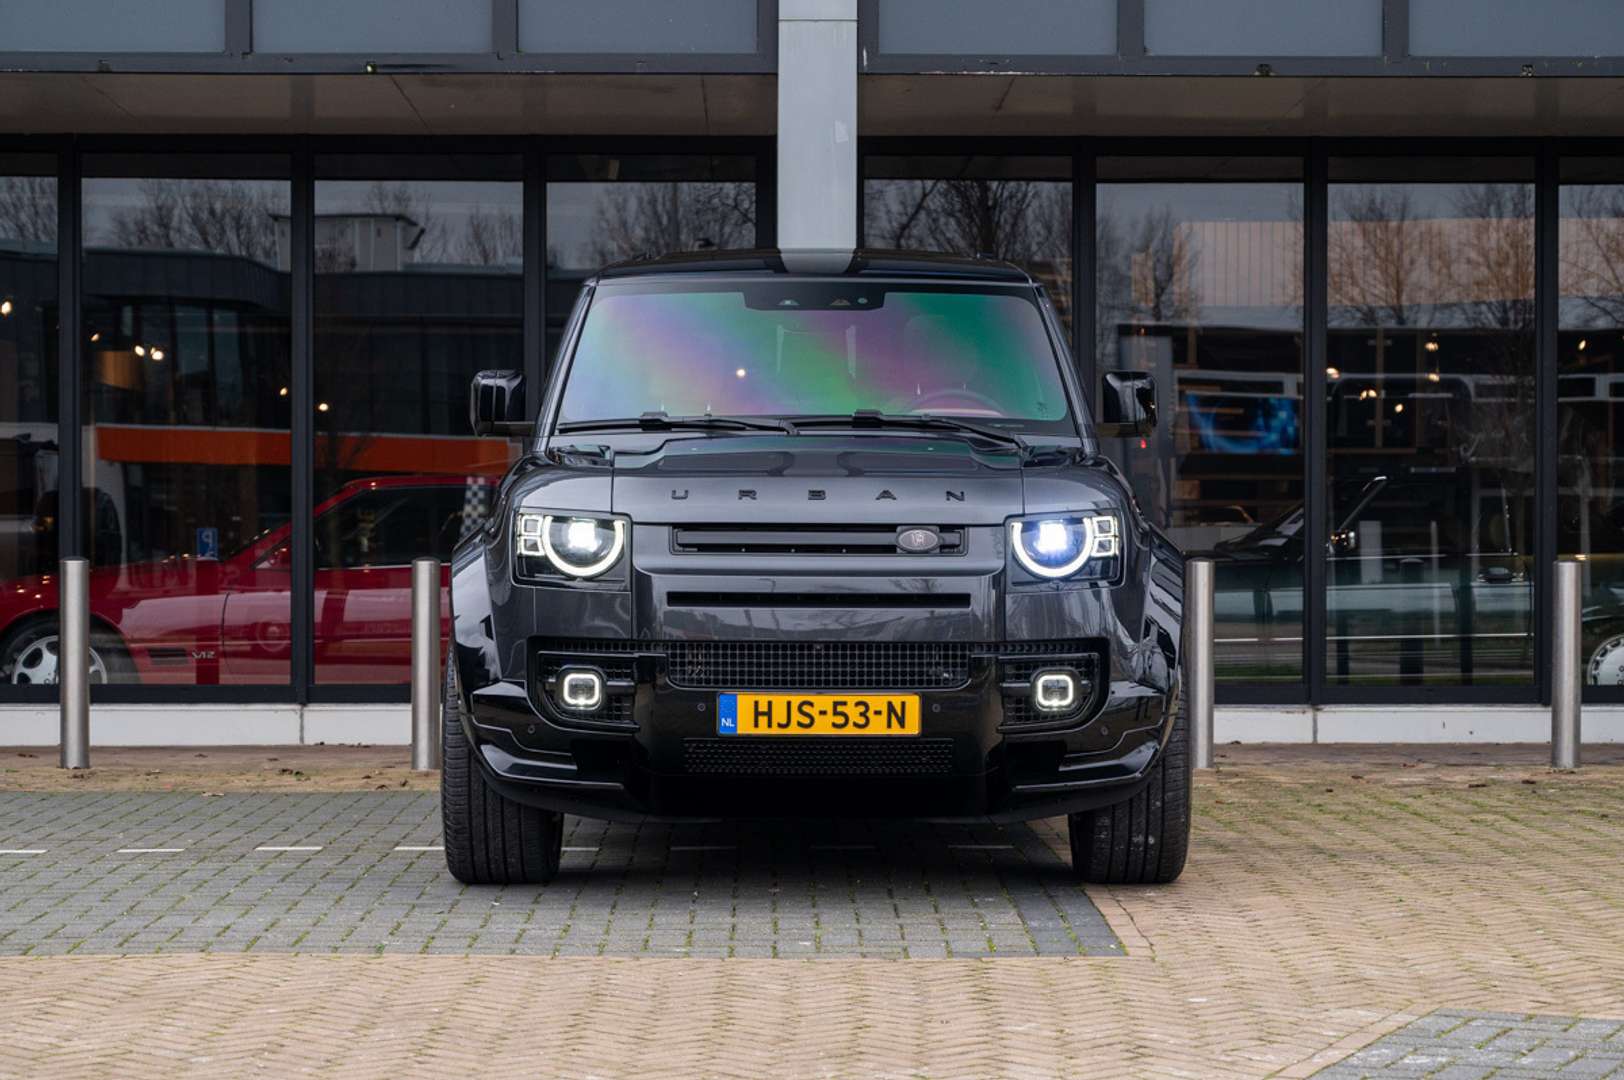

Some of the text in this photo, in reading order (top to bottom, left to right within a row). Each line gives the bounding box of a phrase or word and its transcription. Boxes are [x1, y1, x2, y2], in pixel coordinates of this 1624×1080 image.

[671, 489, 965, 502] URBAN
[753, 700, 907, 730] HJS-53-N
[721, 718, 735, 727] NL
